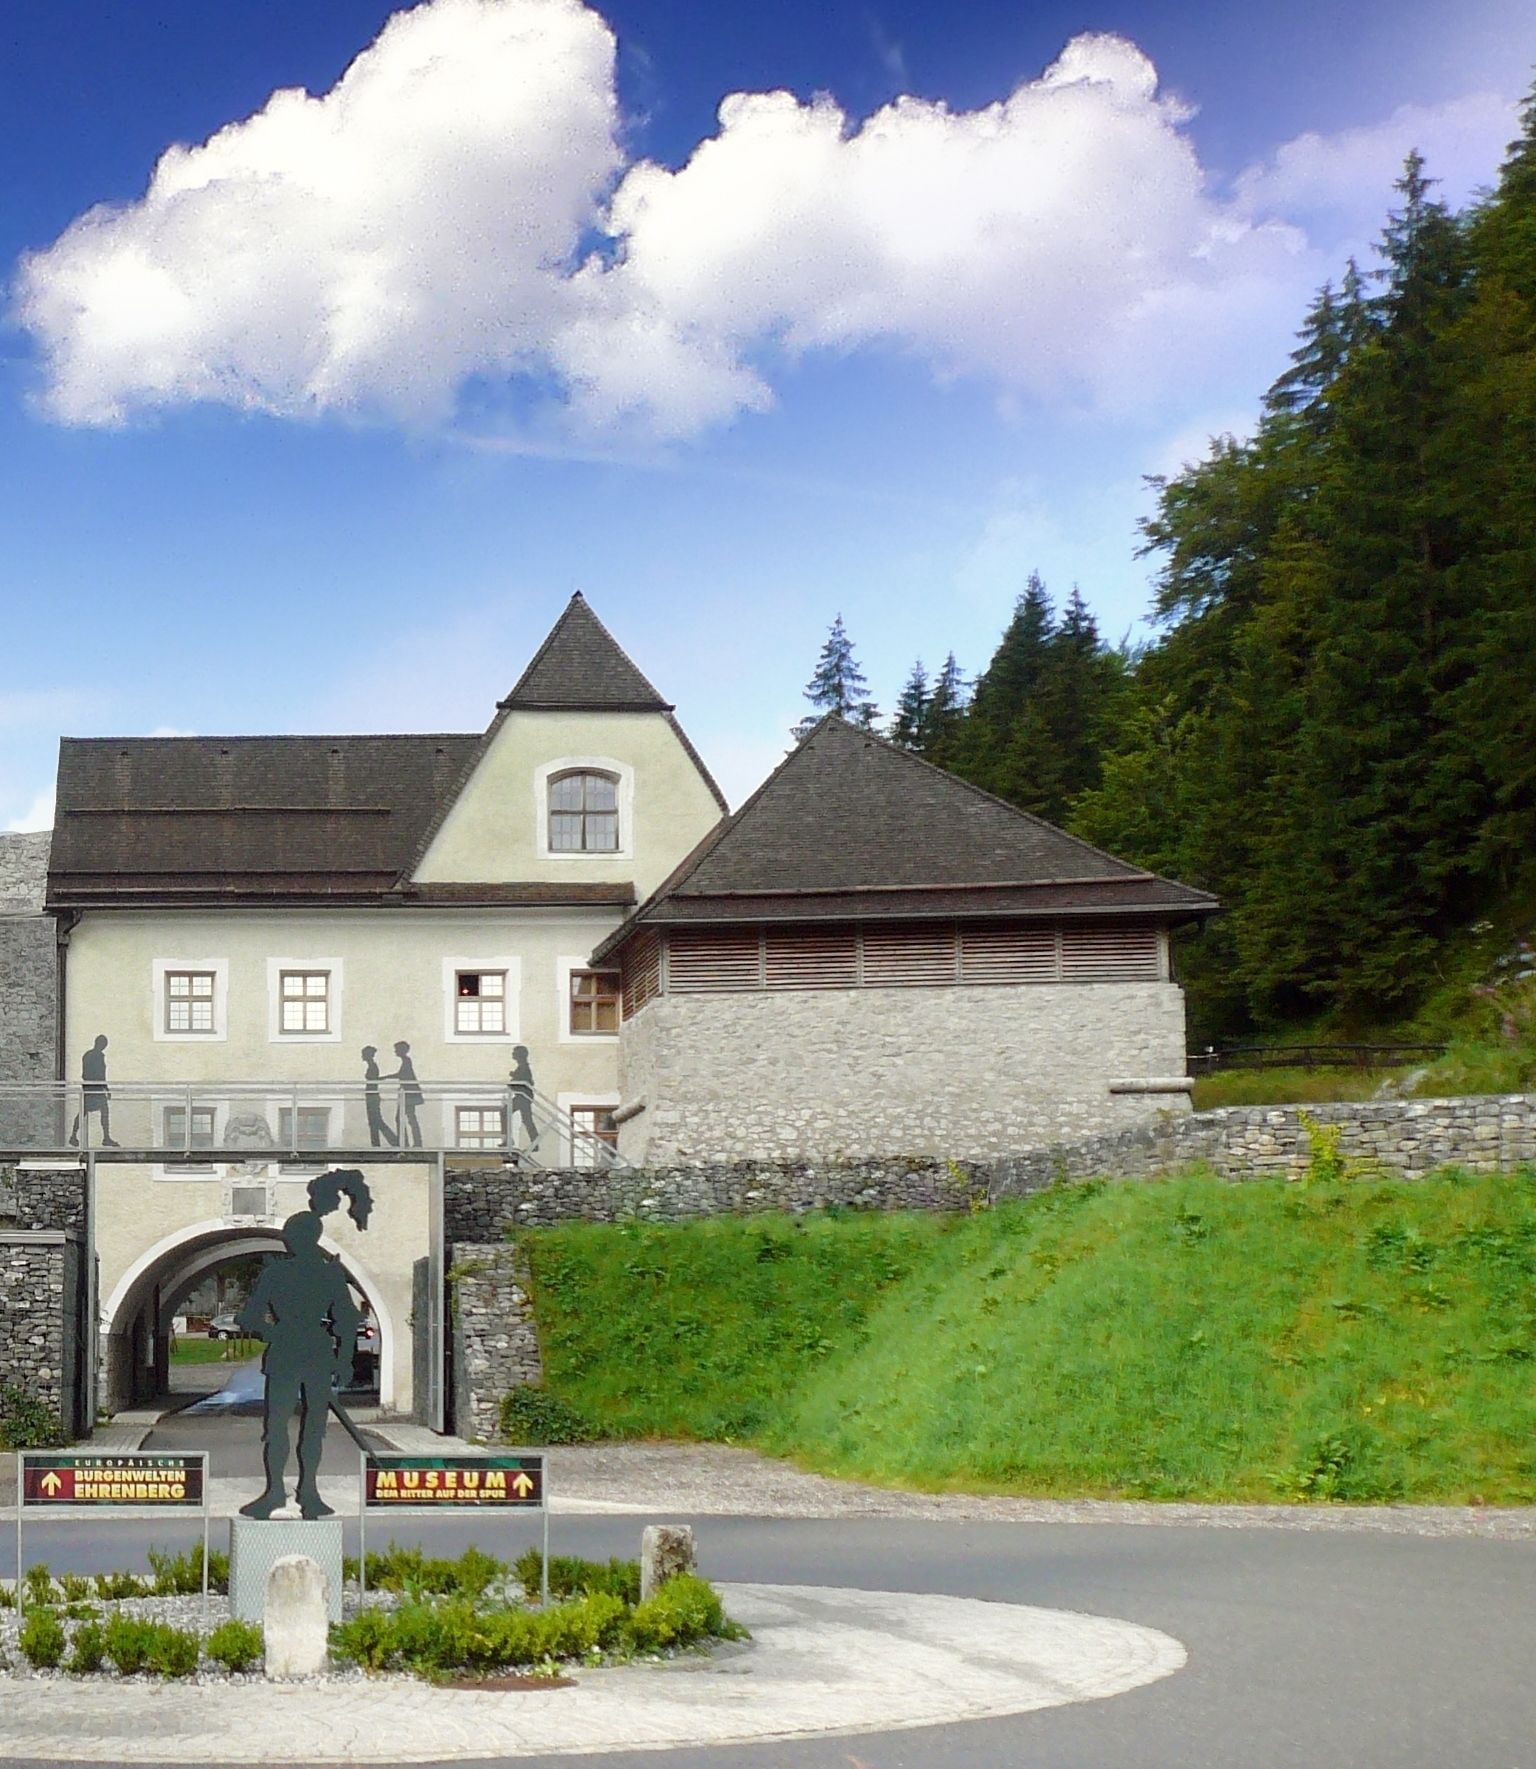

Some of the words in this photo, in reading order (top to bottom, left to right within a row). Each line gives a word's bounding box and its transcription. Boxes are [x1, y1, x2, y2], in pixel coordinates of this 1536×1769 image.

[74, 1458, 185, 1467] EUROPÄISCHE
[74, 1470, 186, 1482] BURGENWELTEN
[376, 1471, 506, 1488] MUSEUM
[74, 1483, 186, 1499] EHRENBERG
[375, 1489, 399, 1498] DEM
[400, 1489, 434, 1498] RITTER
[435, 1489, 456, 1498] AUF
[457, 1489, 477, 1498] DER
[479, 1489, 506, 1498] SPUR
